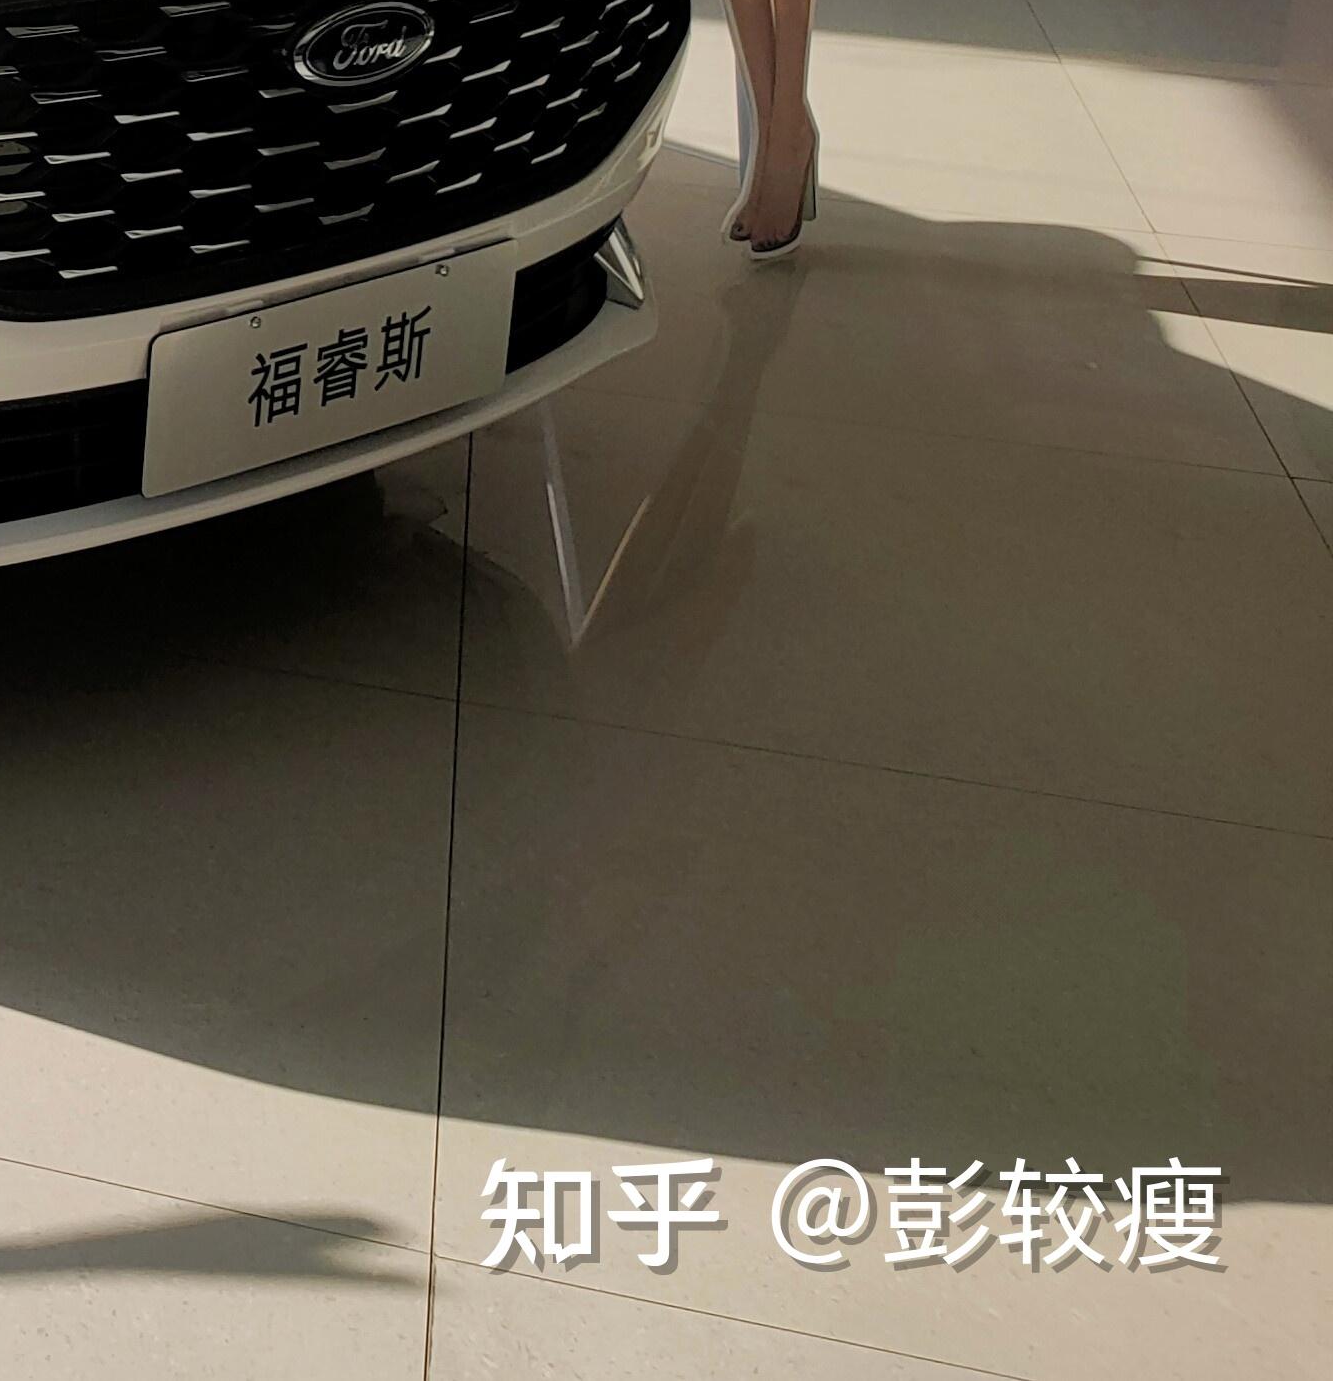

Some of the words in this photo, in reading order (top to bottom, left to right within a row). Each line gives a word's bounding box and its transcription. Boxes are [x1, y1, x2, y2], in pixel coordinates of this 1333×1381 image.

[333, 19, 408, 70] Ford
[247, 305, 432, 427] 福睿斯
